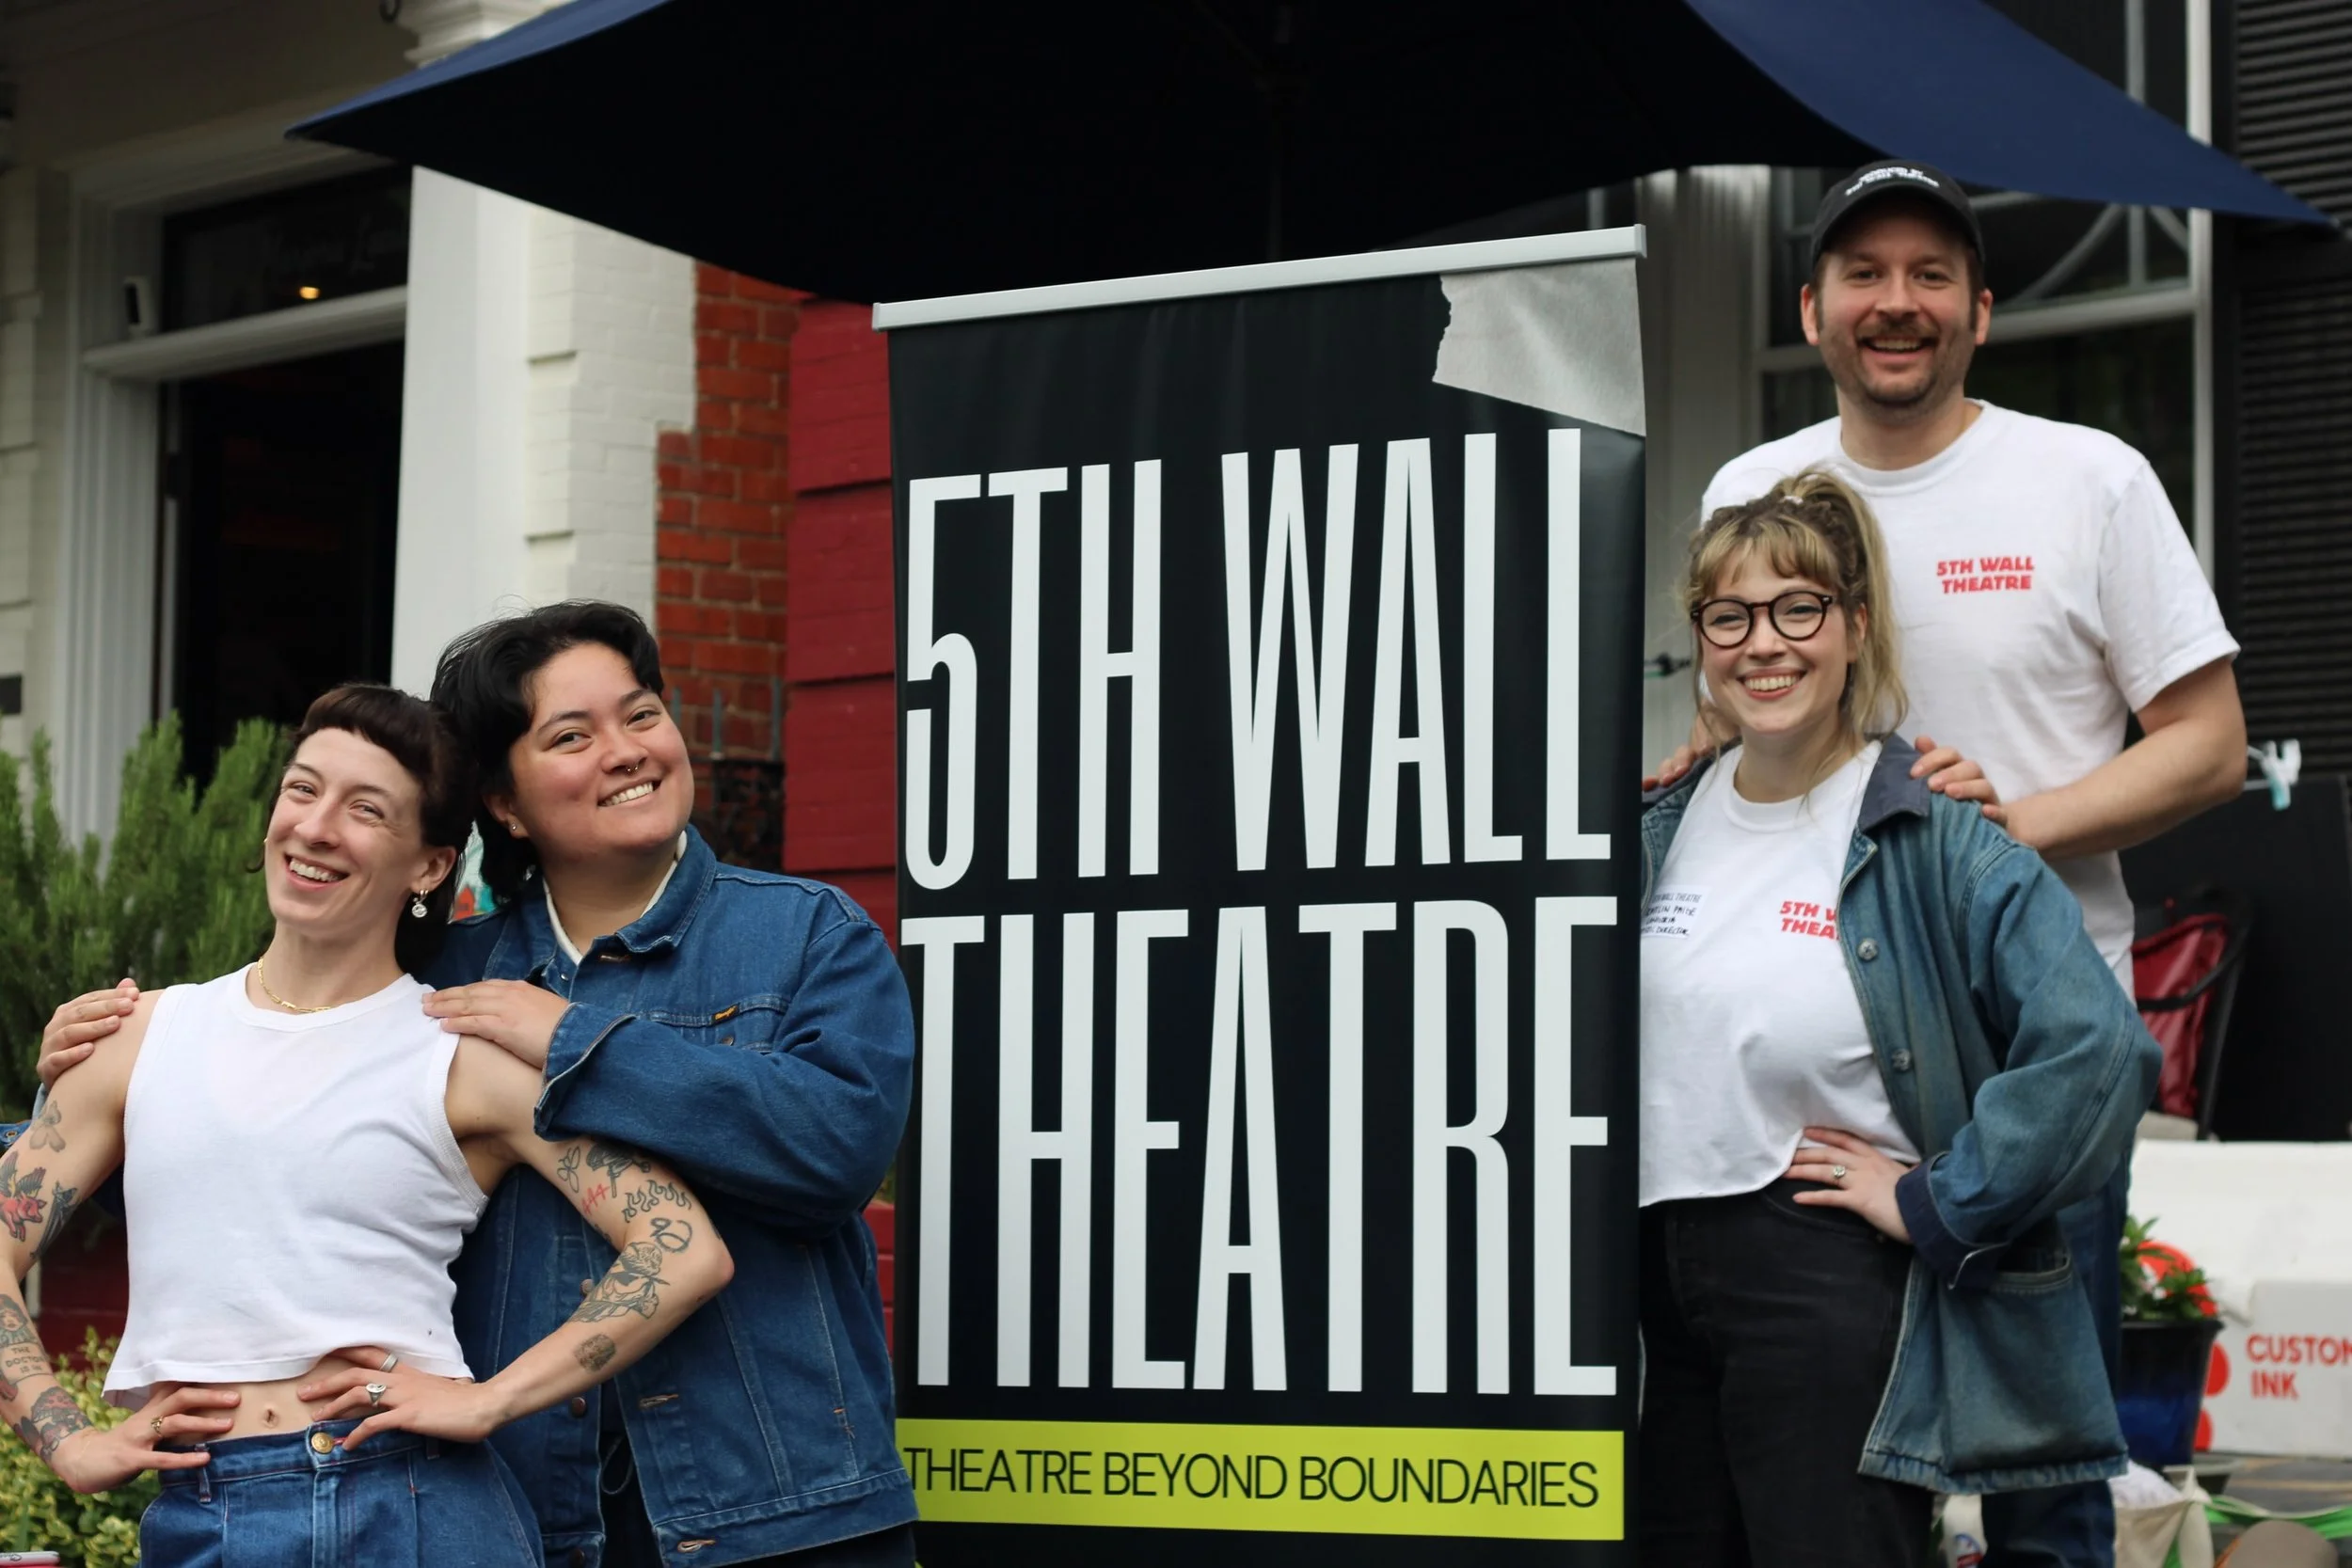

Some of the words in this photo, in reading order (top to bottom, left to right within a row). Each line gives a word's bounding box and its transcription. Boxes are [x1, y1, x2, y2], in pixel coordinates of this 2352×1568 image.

[1936, 560, 1974, 576] 5TH
[1979, 556, 2035, 572] WALL
[1942, 575, 2032, 594] THEATRE
[905, 459, 1162, 890] 5TH
[1222, 428, 1612, 871] WALL
[1780, 900, 1820, 917] 5TH
[1782, 918, 1839, 941] THEA
[900, 896, 1618, 1396] THEATRE
[2250, 1370, 2299, 1400] INK
[903, 1447, 1092, 1495] THEATRE
[1104, 1451, 1287, 1499] BEYOND
[1299, 1456, 1598, 1508] BOUNDARIES
